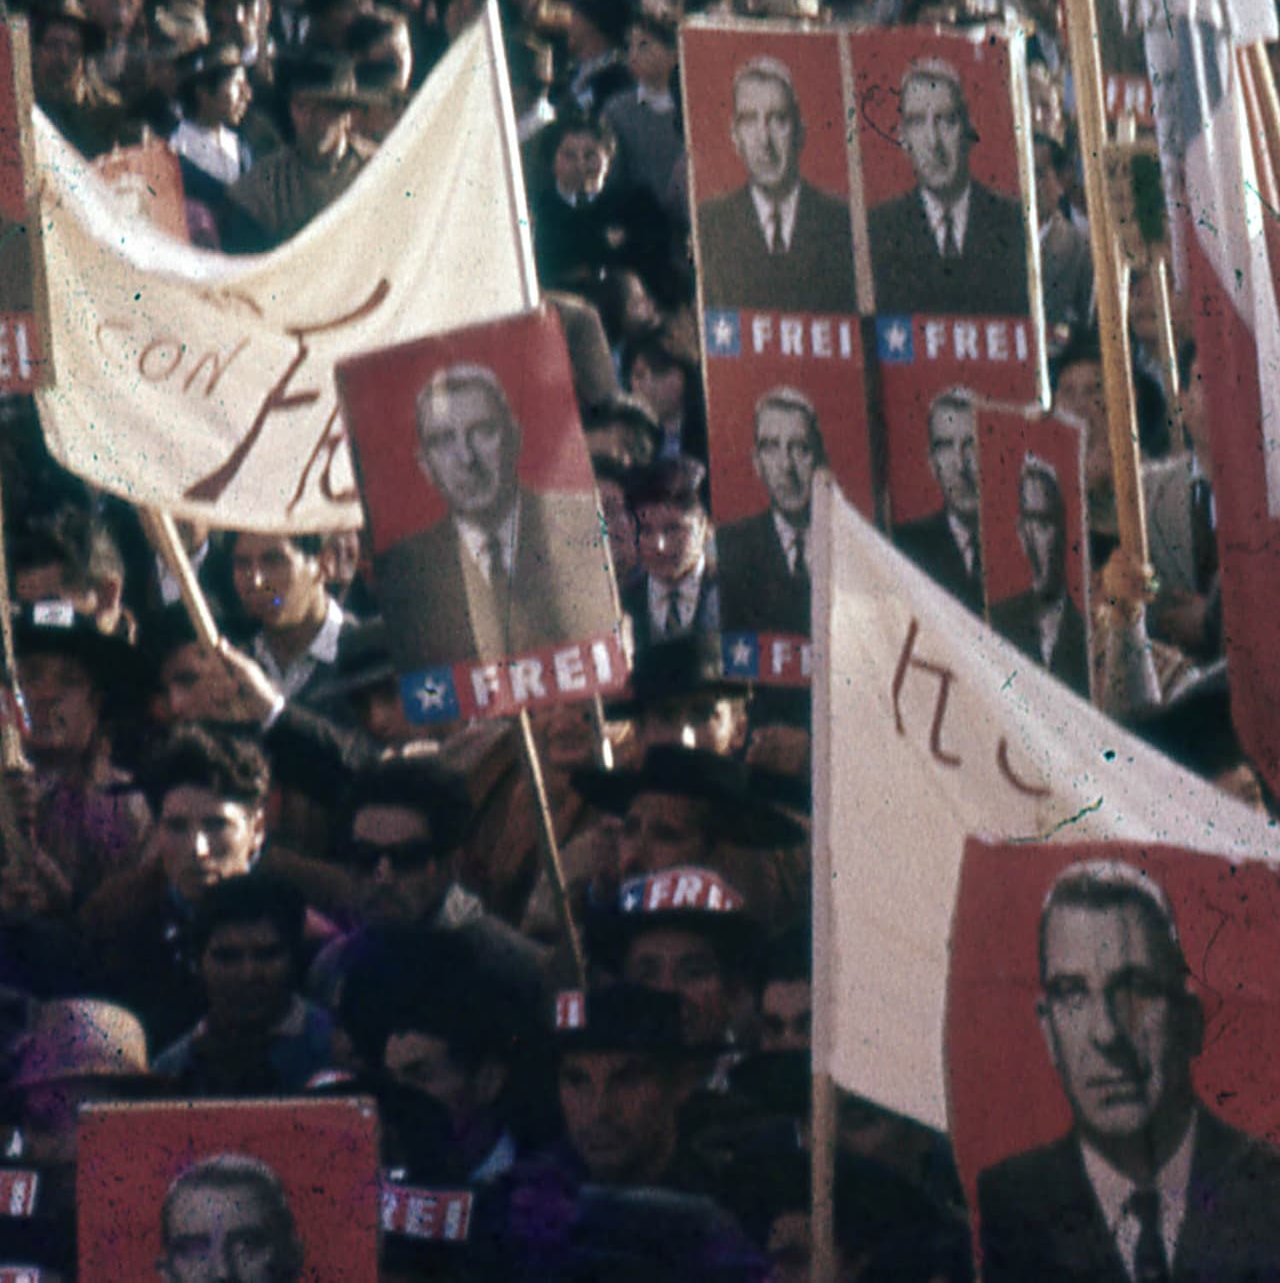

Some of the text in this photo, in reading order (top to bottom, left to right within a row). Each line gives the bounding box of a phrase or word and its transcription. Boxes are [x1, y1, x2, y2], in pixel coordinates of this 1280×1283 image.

[751, 316, 853, 360] FREI
[924, 320, 1030, 362] FREI
[470, 641, 612, 709] FREI
